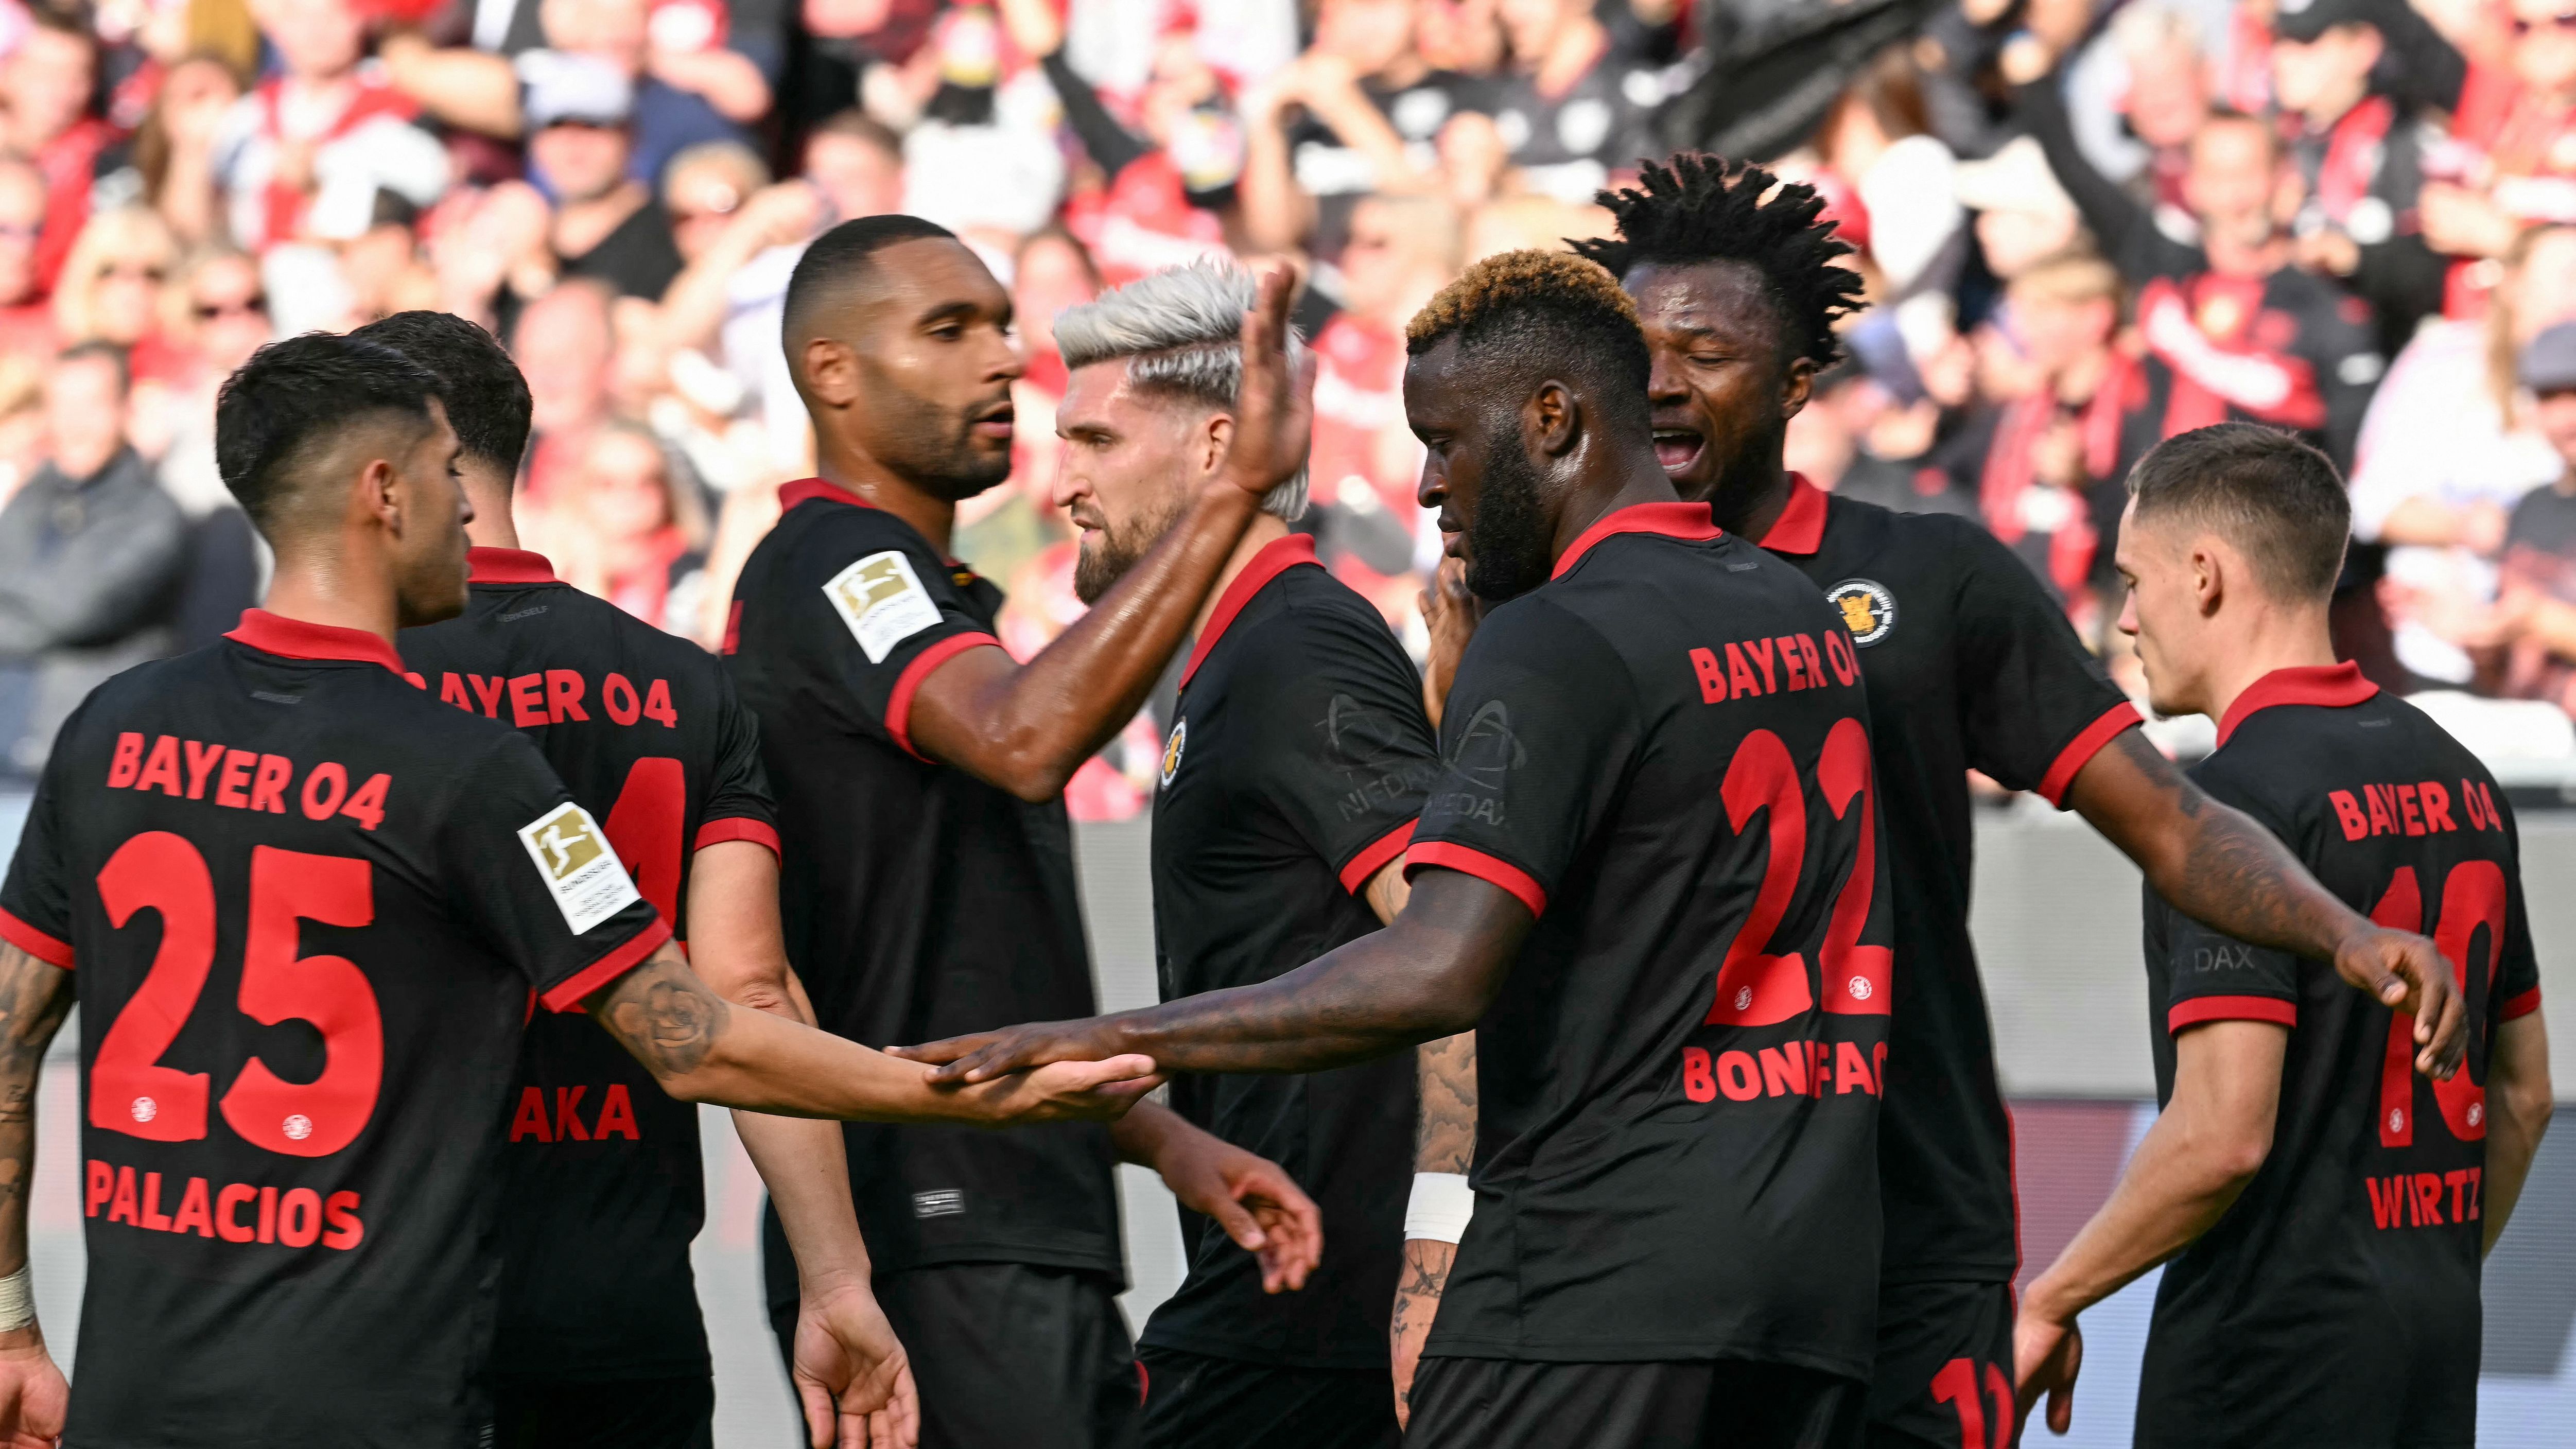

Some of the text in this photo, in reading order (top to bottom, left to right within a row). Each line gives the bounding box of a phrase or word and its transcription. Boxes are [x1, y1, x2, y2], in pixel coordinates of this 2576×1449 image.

[403, 669, 678, 728] AYER 04
[1688, 633, 1828, 704] BAYER
[107, 732, 392, 831] BAYER 04
[2328, 778, 2504, 842] BAYER 04
[1703, 717, 1894, 1027] 22
[88, 830, 385, 1158] 25
[2370, 860, 2507, 1148] 10
[85, 1159, 364, 1251] PALACIOS
[2365, 1167, 2482, 1231] WIRTZ
